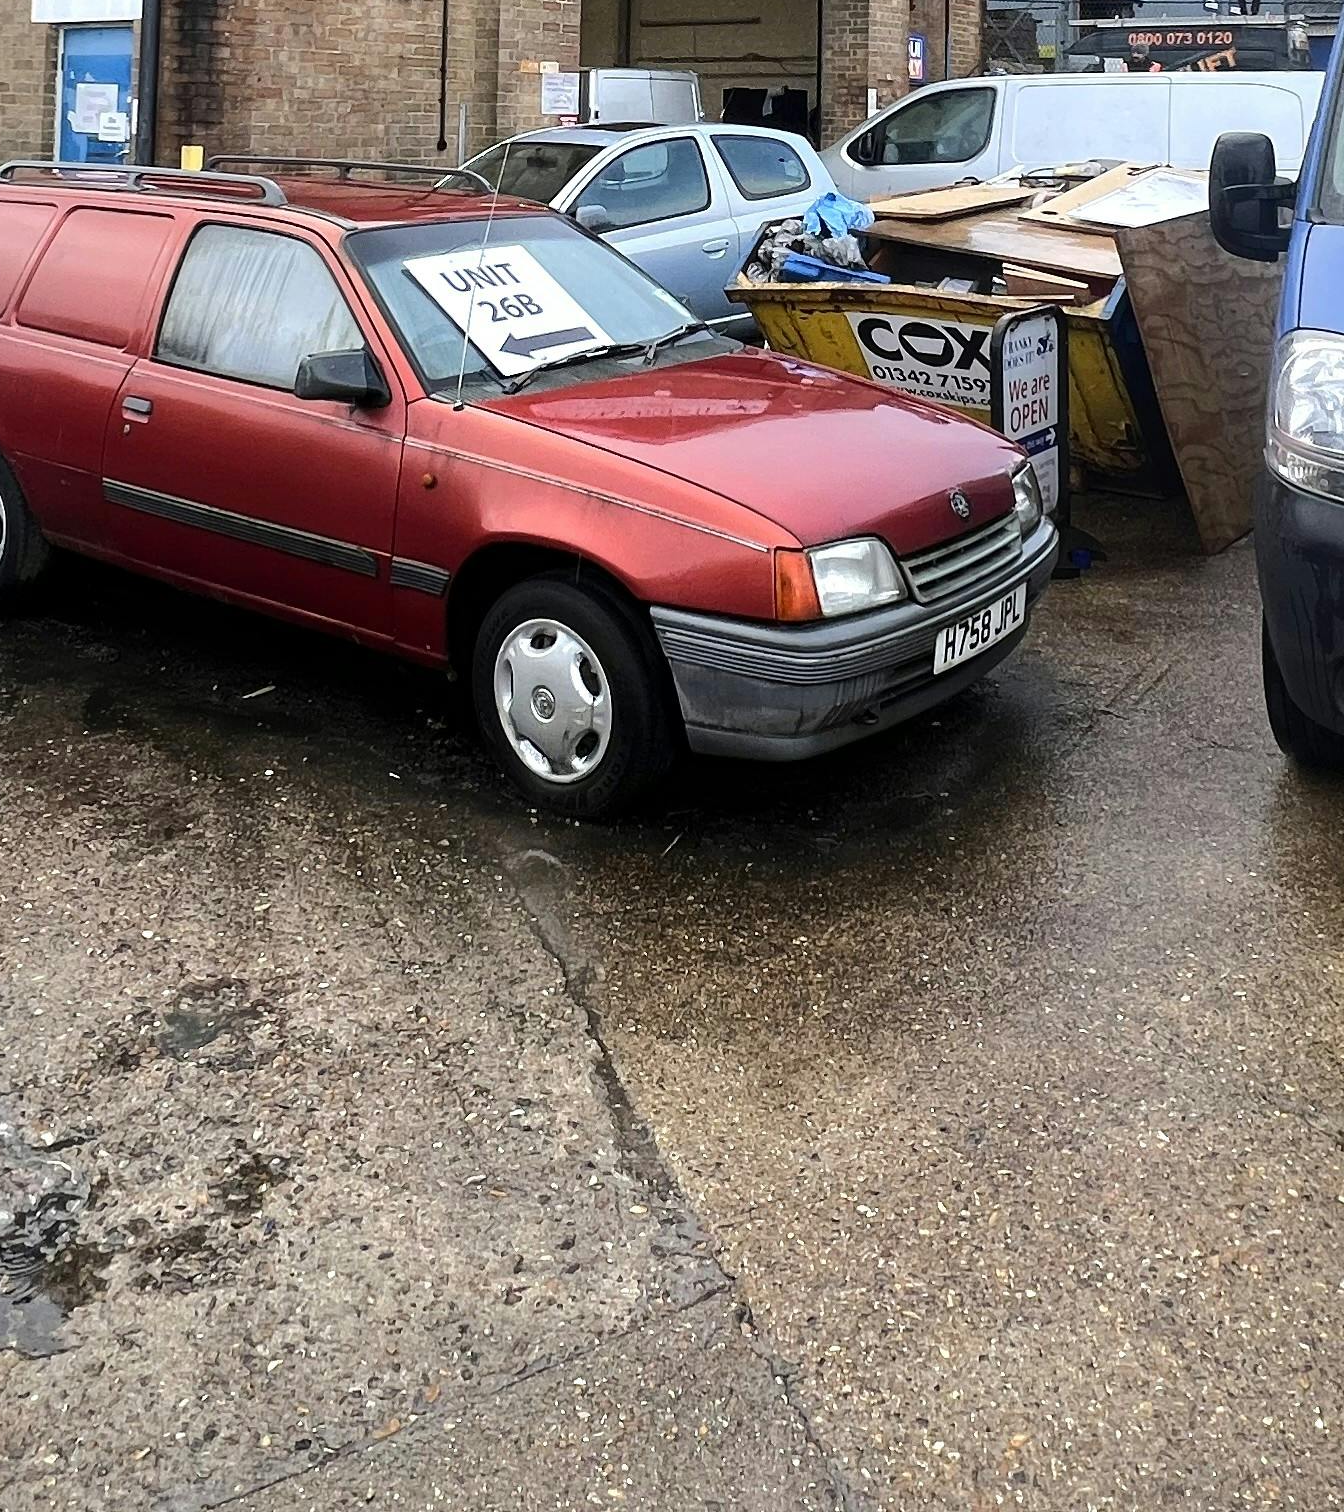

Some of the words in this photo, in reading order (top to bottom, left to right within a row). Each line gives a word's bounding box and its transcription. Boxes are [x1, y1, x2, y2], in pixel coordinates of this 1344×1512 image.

[1128, 33, 1163, 45] 0800
[1166, 32, 1192, 45] 073
[1196, 31, 1233, 45] 0120
[439, 262, 521, 292] UNIT
[477, 293, 544, 322] 26B
[857, 317, 992, 370] COX
[872, 365, 934, 386] 01342
[1008, 379, 1029, 403] We
[1031, 373, 1050, 396] are
[1010, 395, 1049, 434] OPEN
[943, 609, 992, 664] H758
[995, 591, 1020, 635] JPL
